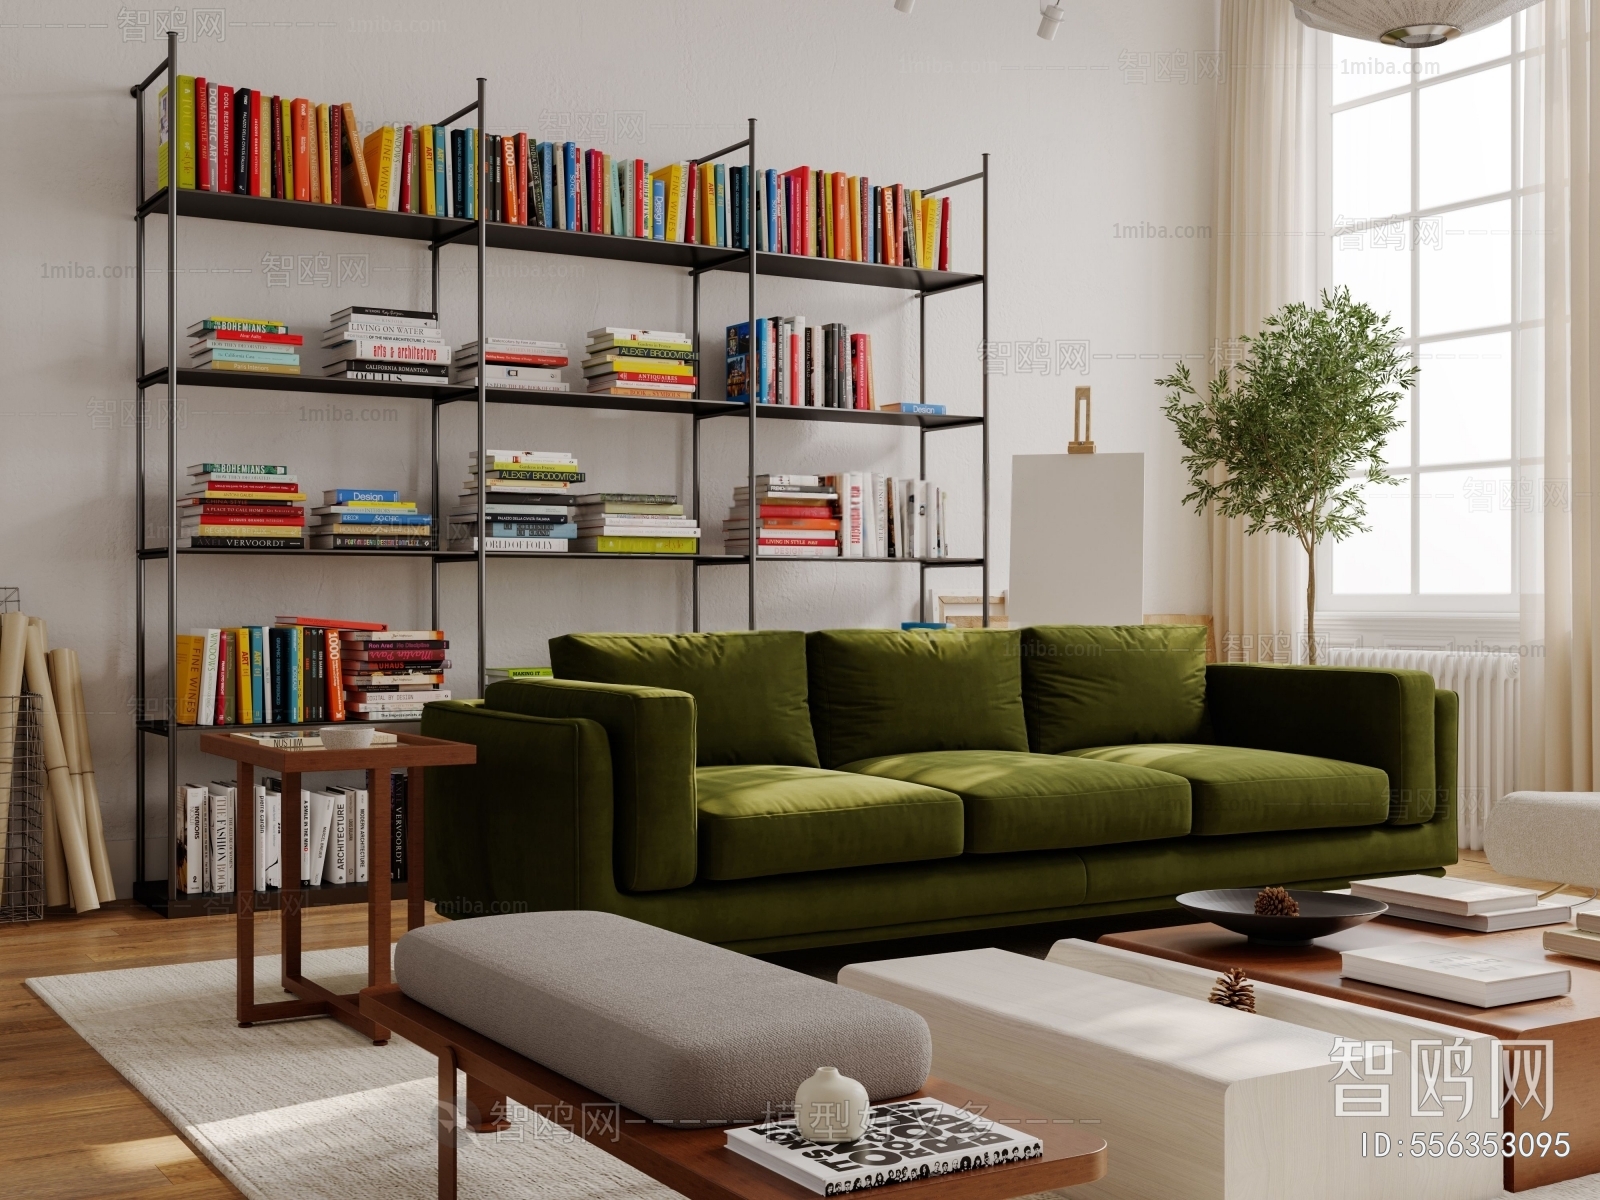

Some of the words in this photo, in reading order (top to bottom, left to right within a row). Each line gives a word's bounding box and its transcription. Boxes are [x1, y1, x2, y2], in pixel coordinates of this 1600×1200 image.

[209, 88, 217, 142] DOMESTIC
[262, 102, 270, 138] REGENCY
[308, 108, 316, 154] HOLLYWOOD
[209, 144, 217, 163] ART
[262, 139, 270, 163] REDUX
[382, 138, 393, 162] FINE
[393, 126, 403, 164] WINDOWS
[504, 139, 515, 166] 1000
[352, 130, 363, 159] Moroccan
[359, 160, 369, 187] Interiors
[311, 155, 319, 191] INTERIORS
[379, 166, 390, 200] WINES
[671, 175, 679, 197] FINE
[654, 196, 662, 225] Design
[884, 189, 892, 214] 1000
[668, 204, 677, 232] WINES
[925, 232, 933, 261] WINES
[221, 321, 267, 334] BOHEMIANS
[351, 323, 381, 333] LIVING
[382, 325, 395, 334] ON
[396, 326, 424, 336] WATER
[373, 344, 387, 358] arts
[390, 347, 395, 359] &
[397, 344, 437, 362] architecture
[621, 347, 649, 356] ALEXEY
[650, 348, 695, 361] BRODOVITCH
[365, 363, 398, 372] CALIFORNIA
[398, 365, 429, 374] ROMANTICA
[638, 373, 678, 381] ANTIQUAIRES
[913, 405, 935, 414] Design
[221, 464, 266, 474] BOHEMIANS
[501, 471, 531, 479] ALEXEY
[532, 471, 581, 481] BRODOVITCH
[353, 492, 384, 502] Design
[204, 526, 240, 534] REGENCY
[241, 527, 268, 535] REDUX
[197, 538, 224, 546] AXEL
[226, 539, 286, 547] VERVOORDT
[774, 547, 804, 555] DESIGN
[207, 632, 217, 672] WINDOWS
[328, 632, 340, 660] 1000
[369, 650, 395, 661] Parr
[398, 649, 433, 661] Martin
[191, 647, 201, 673] FINE
[241, 651, 249, 666] ART
[254, 651, 262, 666] ART
[187, 677, 198, 713] WINES
[216, 797, 227, 817] THE
[216, 819, 227, 862] FASHION
[337, 803, 345, 870] ARCHITECTURE
[193, 875, 198, 883] 2
[216, 863, 227, 892] BOOK
